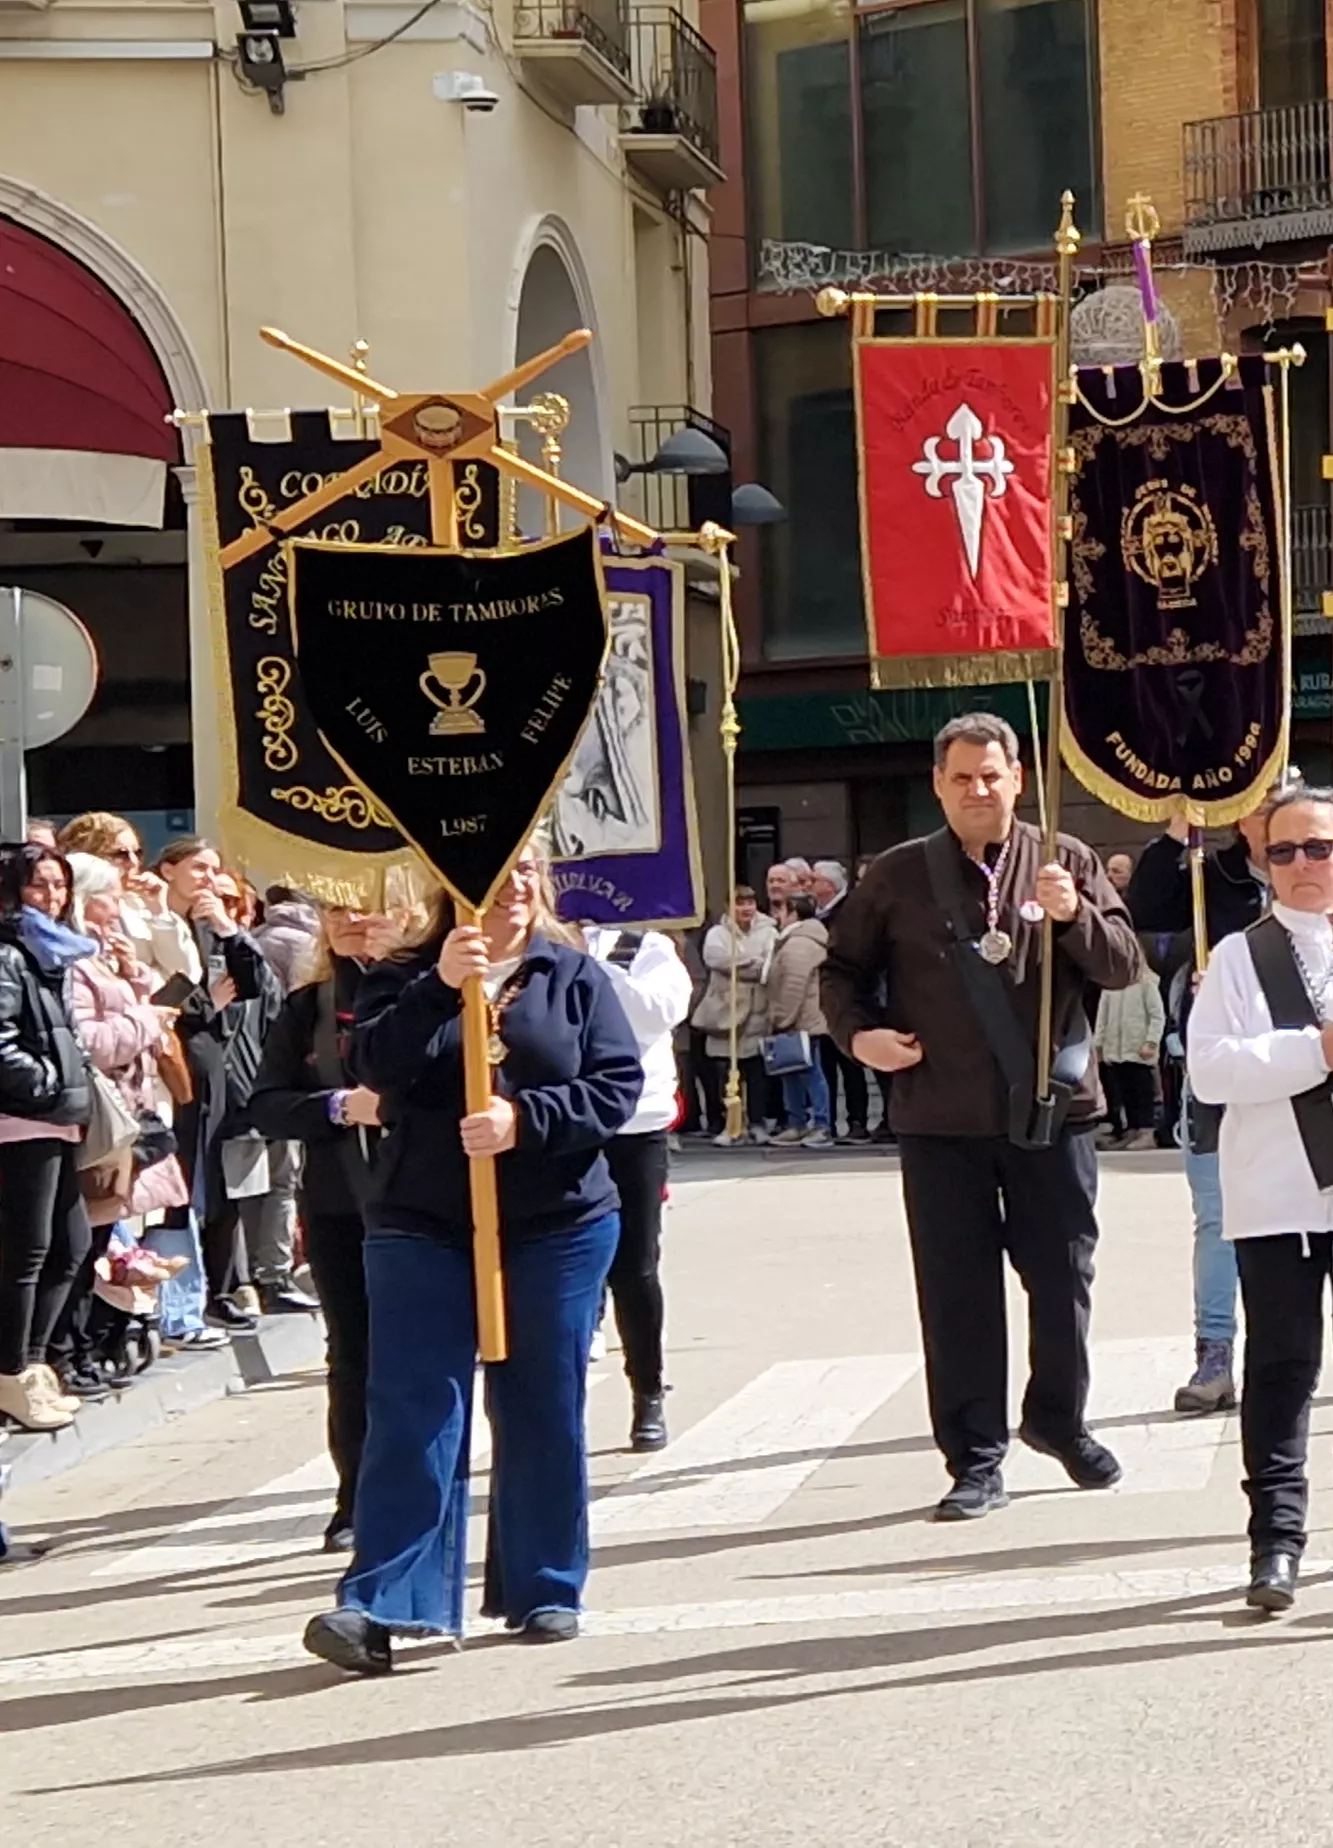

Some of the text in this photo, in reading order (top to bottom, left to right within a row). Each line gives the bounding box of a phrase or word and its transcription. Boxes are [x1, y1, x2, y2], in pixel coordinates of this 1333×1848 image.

[327, 599, 406, 621] GRUPO
[412, 602, 443, 622] DE
[345, 696, 389, 743] LUIS
[520, 671, 573, 745] FELIPE
[407, 750, 505, 776] ESTEBAN
[1105, 730, 1182, 791] FUNDADA
[1191, 766, 1233, 790] AÑO
